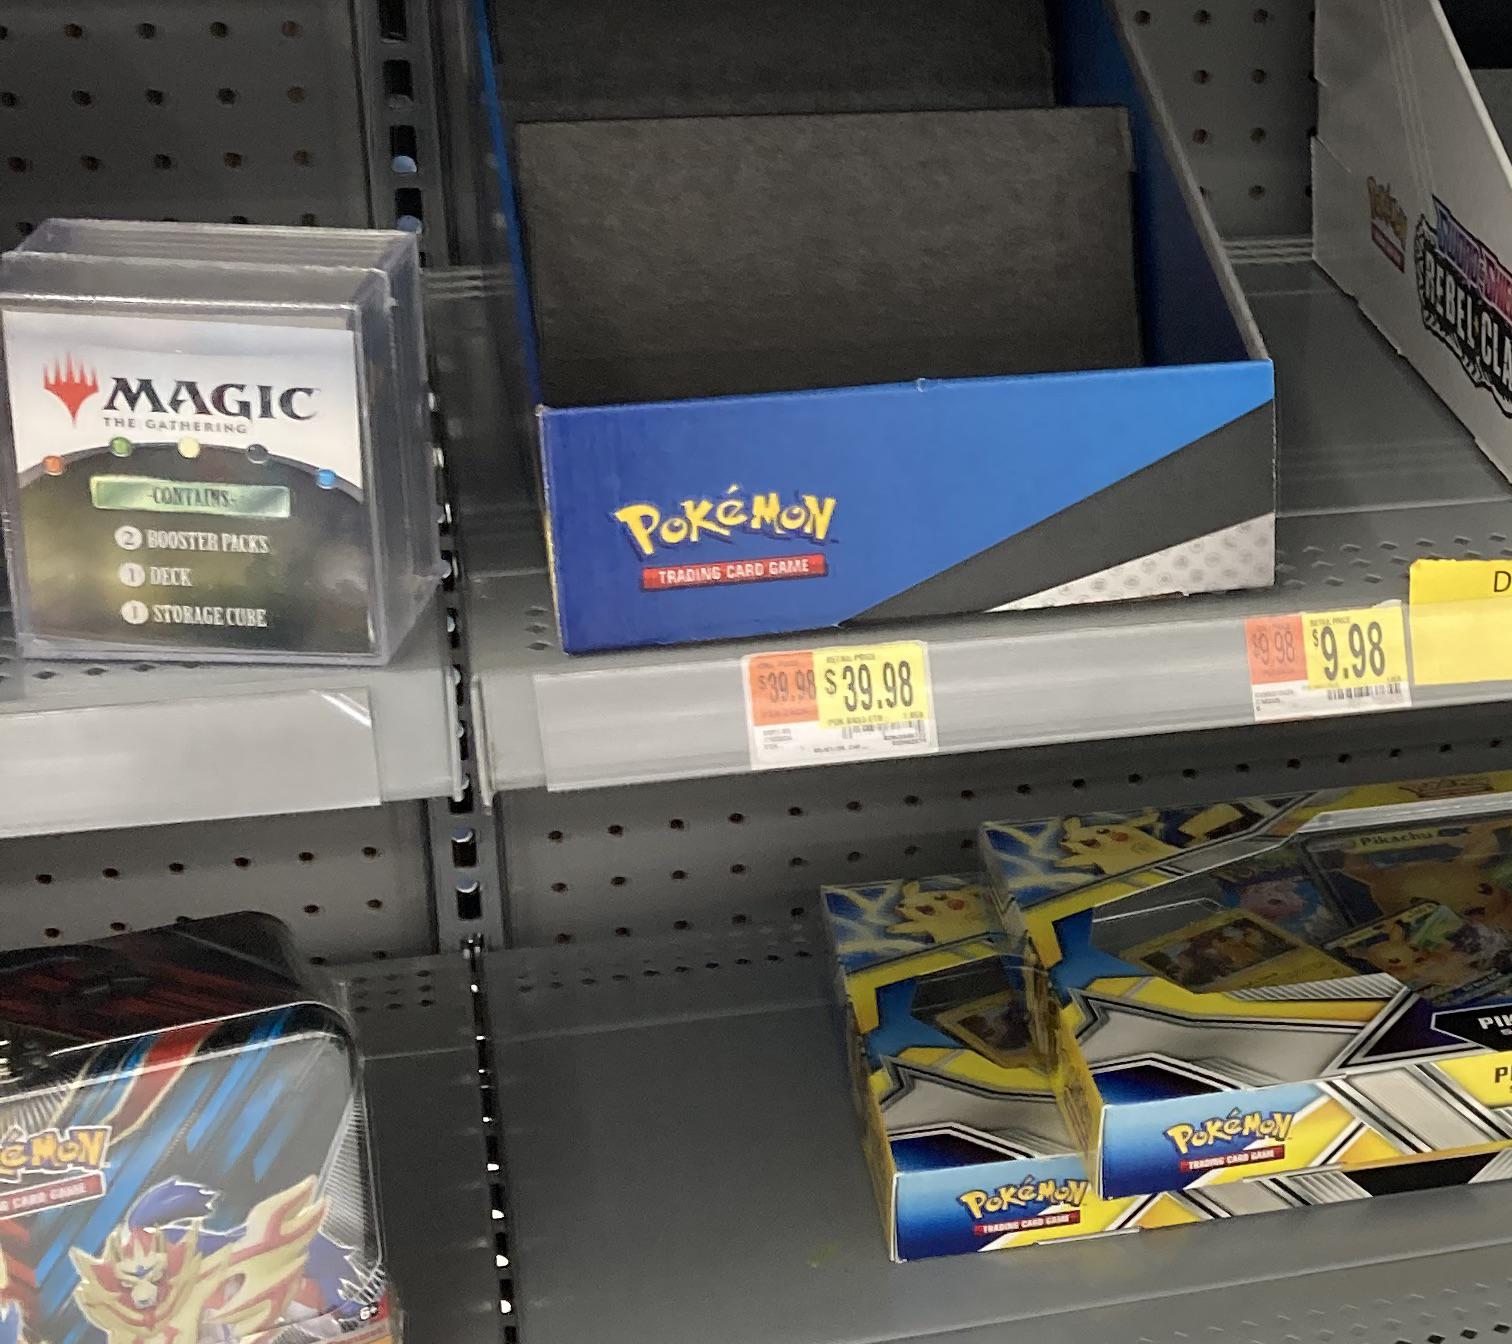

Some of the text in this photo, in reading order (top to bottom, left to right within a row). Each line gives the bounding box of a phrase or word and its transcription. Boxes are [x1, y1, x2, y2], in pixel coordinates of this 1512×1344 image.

[103, 377, 321, 422] MAGIC
[104, 418, 247, 435] THE GATHERING
[146, 529, 218, 551] BOOSTER
[221, 533, 271, 553] PACKS
[150, 566, 192, 586] DECK
[659, 559, 809, 585] TRADING CARD GAME
[153, 604, 267, 627] STORAGE CUBE
[1312, 621, 1385, 680] $9.98
[824, 660, 913, 712] $39.98
[1189, 1157, 1225, 1171] TRADING
[1227, 1154, 1249, 1167] CARD
